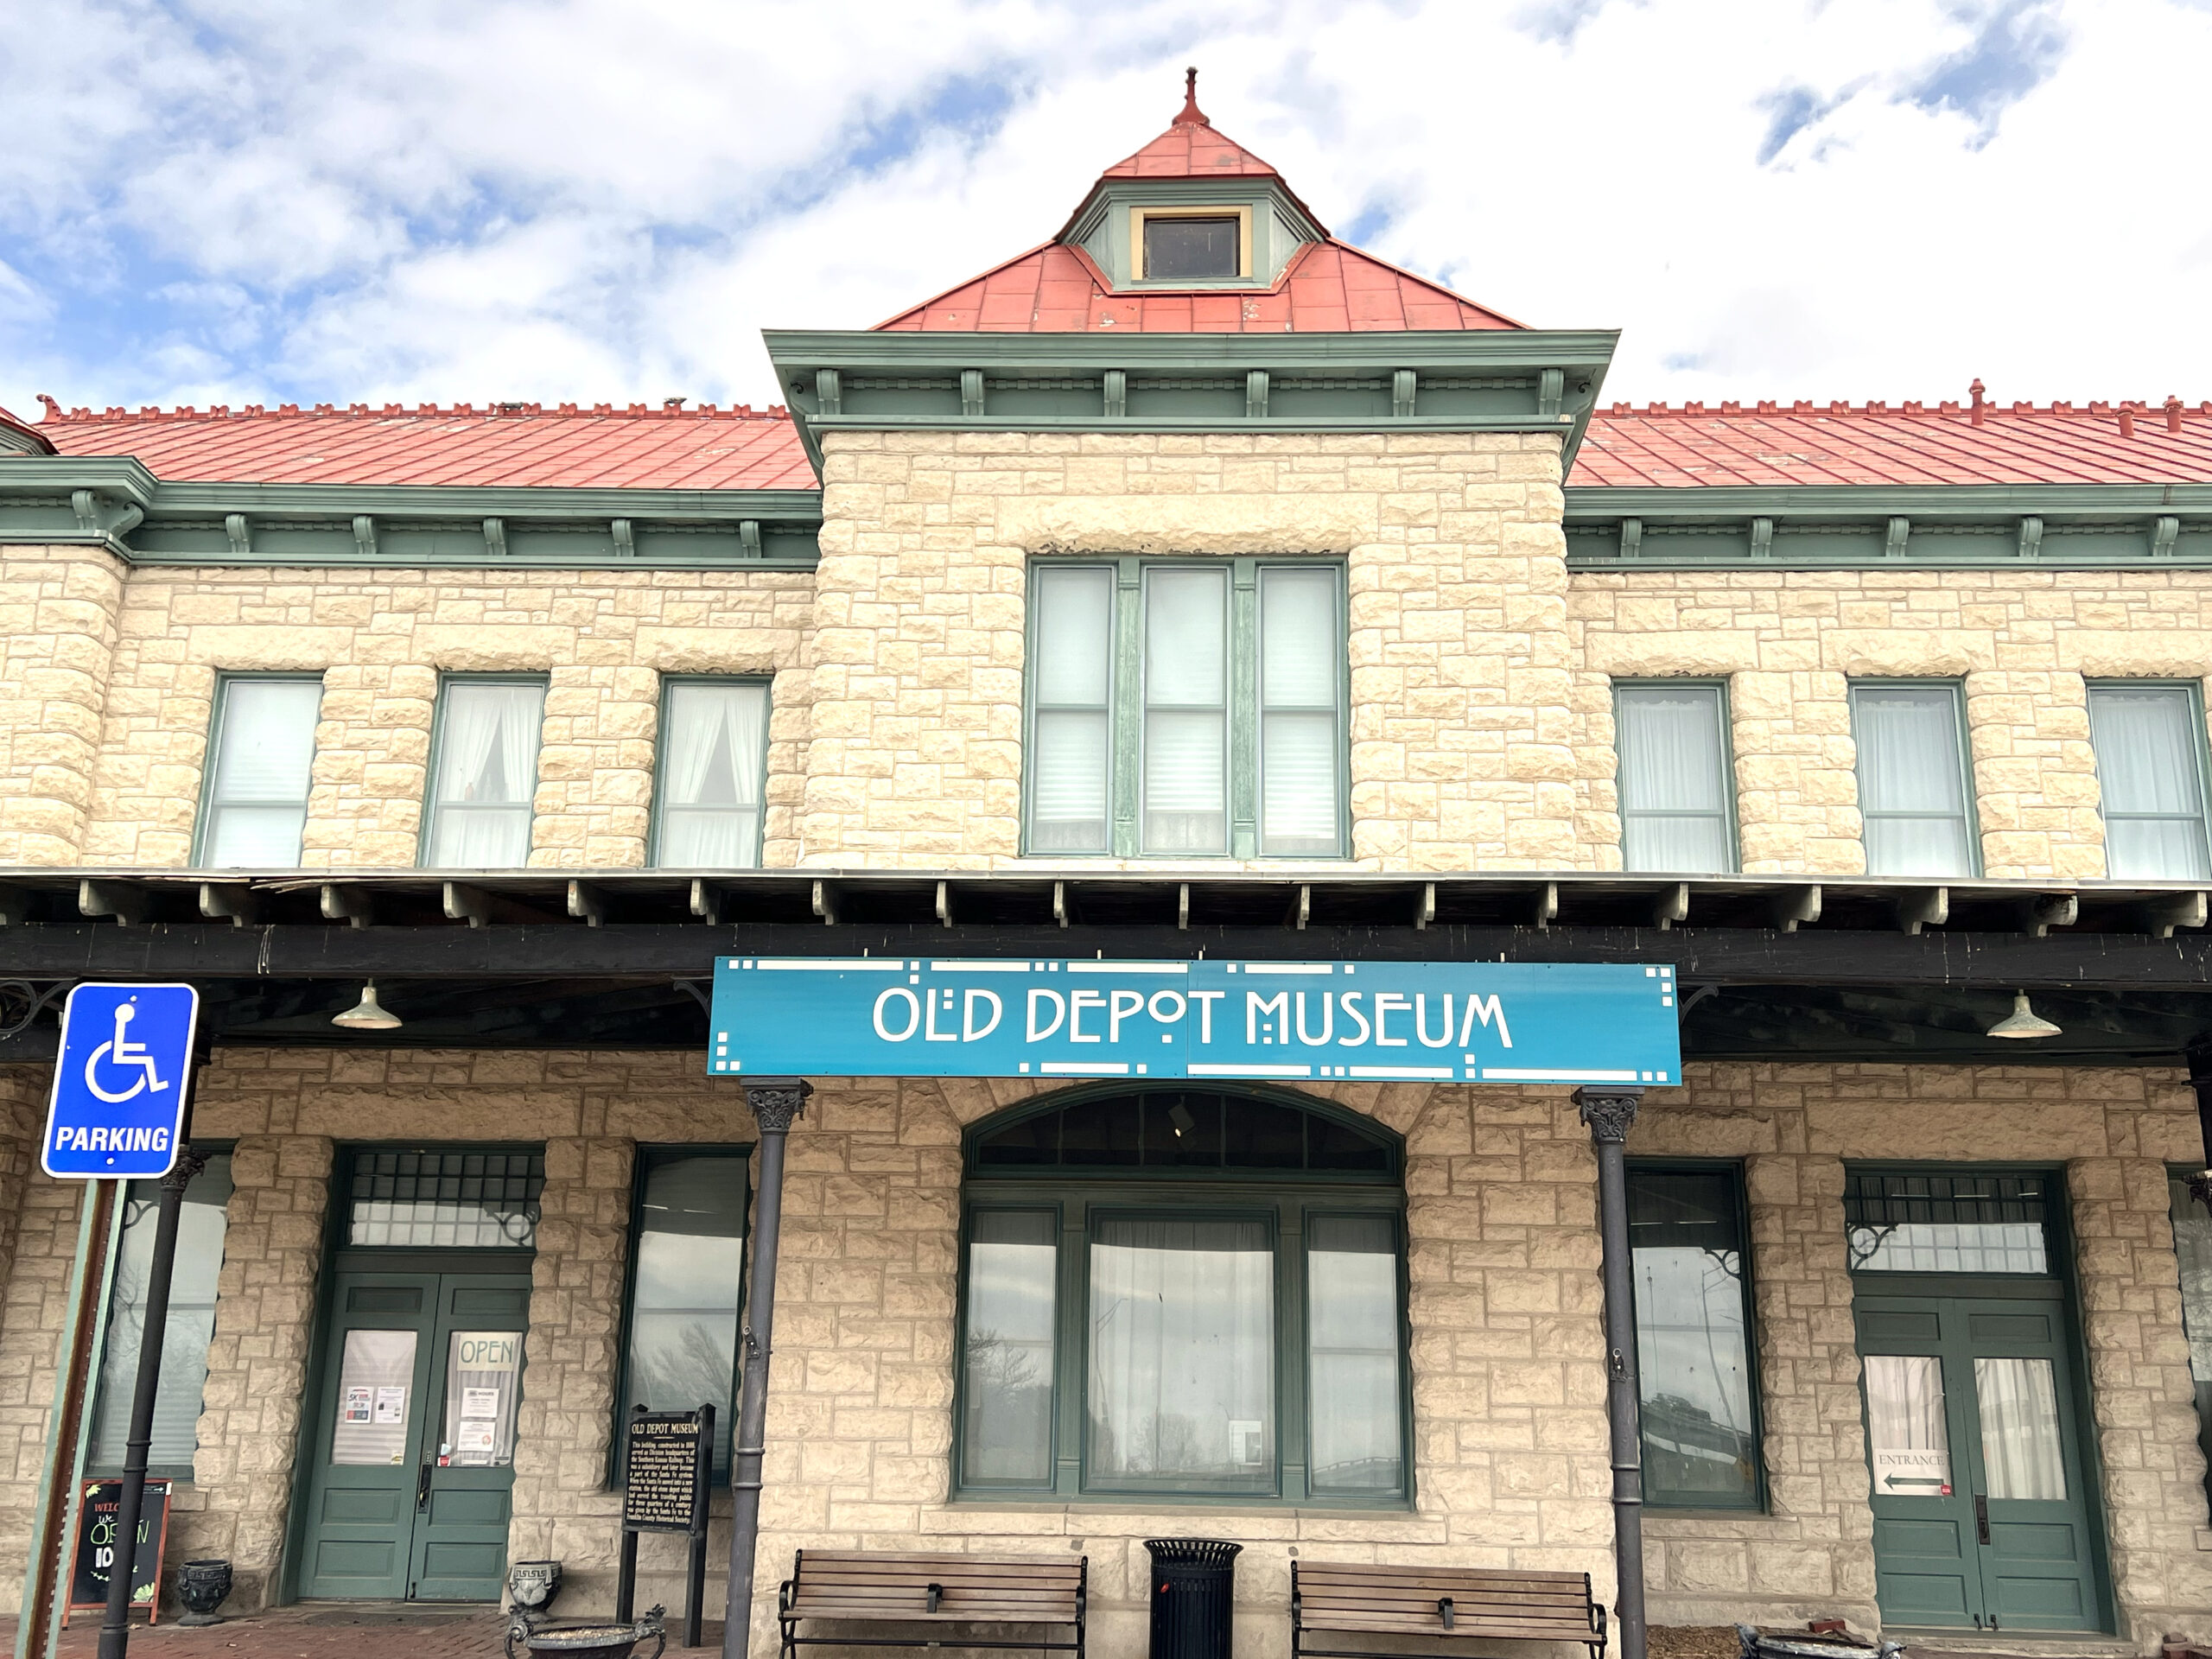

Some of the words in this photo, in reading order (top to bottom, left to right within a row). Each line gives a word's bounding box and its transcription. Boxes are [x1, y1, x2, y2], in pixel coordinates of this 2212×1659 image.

[872, 988, 1003, 1043] OLD
[1026, 988, 1225, 1044] DEPOT
[1246, 990, 1513, 1048] MUSEUM
[55, 1127, 169, 1152] PARKING
[461, 1341, 513, 1363] OPEN
[632, 1423, 645, 1434] OLD
[646, 1423, 670, 1434] DEPOT
[671, 1423, 698, 1434] MUSEUM
[1878, 1454, 1945, 1465] ENTRANCE
[91, 1521, 149, 1544] OPN
